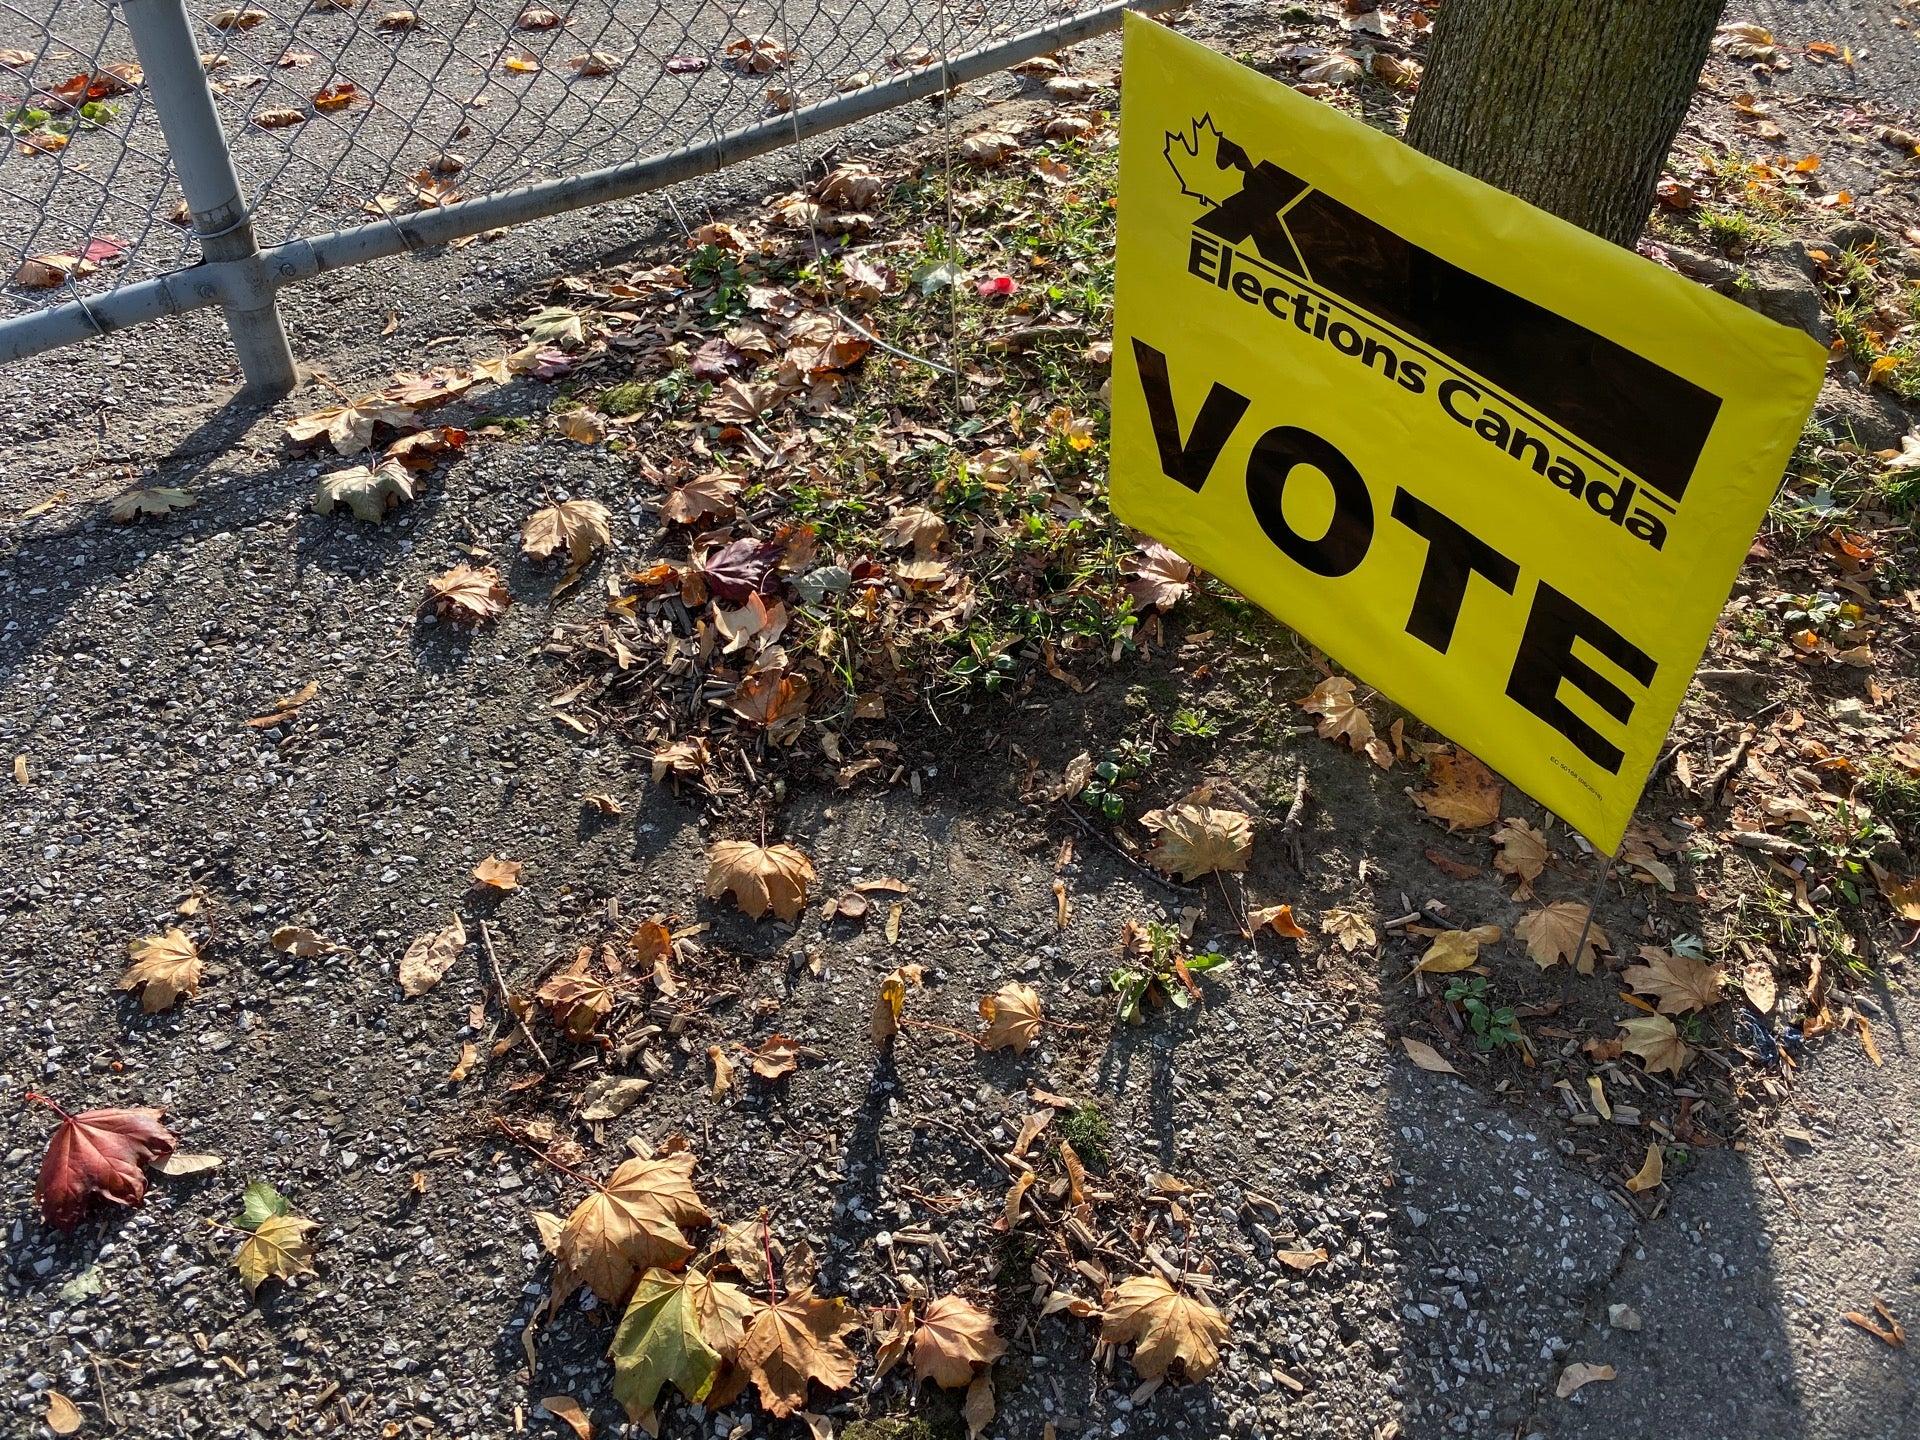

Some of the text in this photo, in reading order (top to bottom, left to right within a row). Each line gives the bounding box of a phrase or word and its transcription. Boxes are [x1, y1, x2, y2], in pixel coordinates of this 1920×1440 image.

[1131, 336, 1659, 776] VOTE
[1188, 238, 1668, 552] Elections Canada
